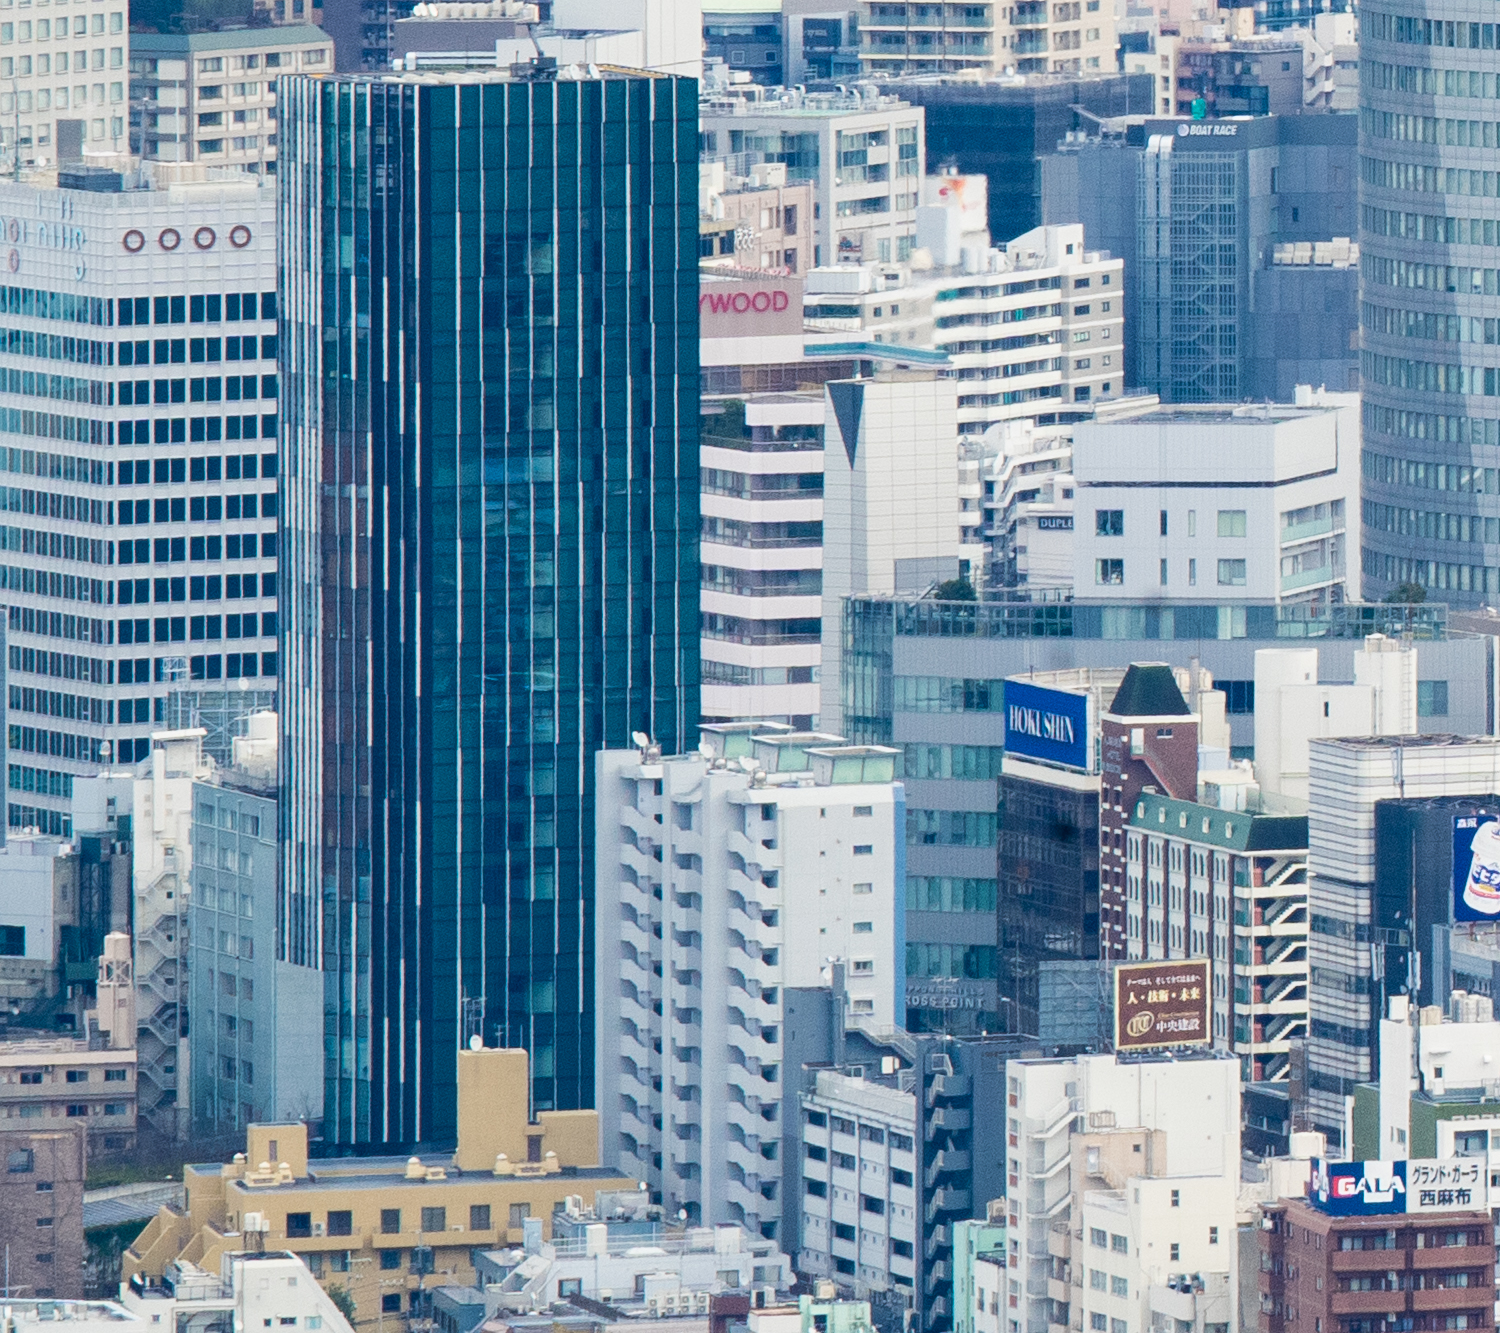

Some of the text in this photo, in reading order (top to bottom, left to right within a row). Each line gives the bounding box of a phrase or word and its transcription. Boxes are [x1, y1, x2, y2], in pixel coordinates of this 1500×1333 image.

[1190, 124, 1238, 136] BOAT RACE
[1009, 704, 1074, 745] HOKUSHIN
[1337, 1175, 1406, 1197] GALA
[1412, 1164, 1479, 1186] グランド・ガーラ
[1419, 1188, 1472, 1207] 西麻布
